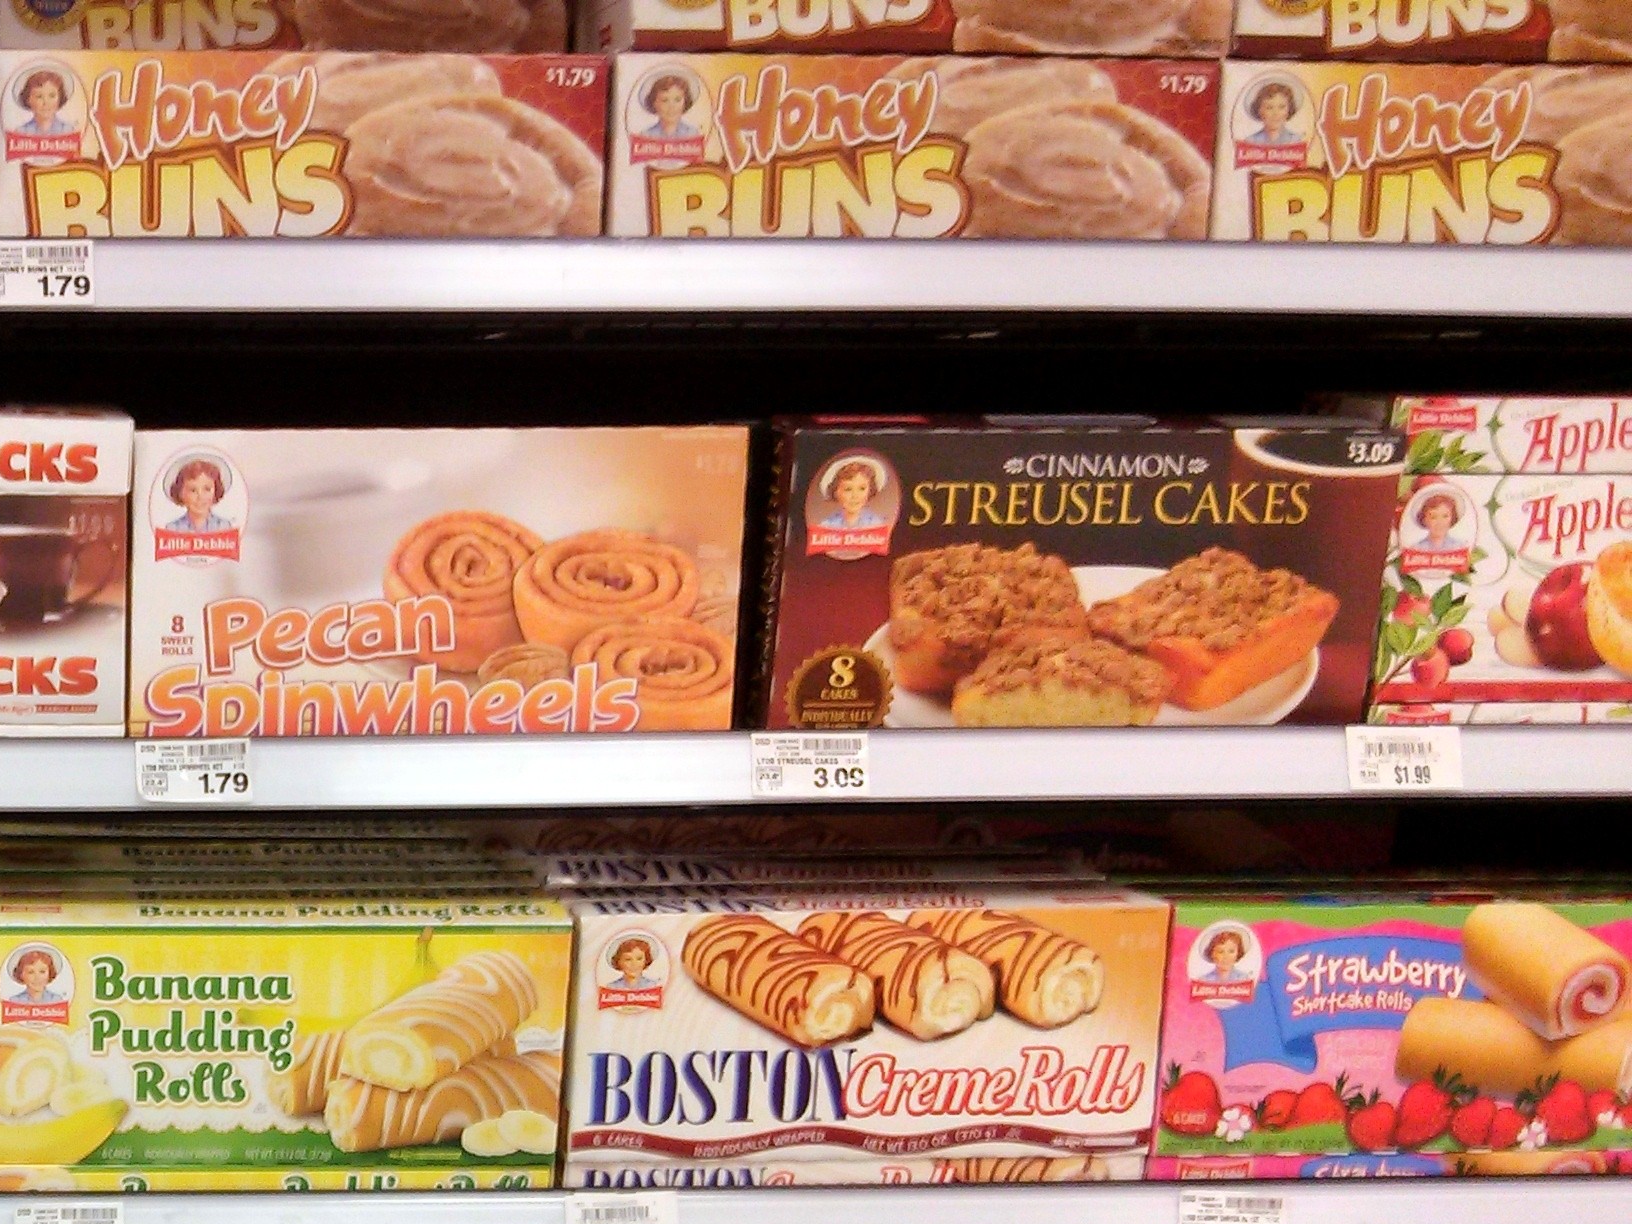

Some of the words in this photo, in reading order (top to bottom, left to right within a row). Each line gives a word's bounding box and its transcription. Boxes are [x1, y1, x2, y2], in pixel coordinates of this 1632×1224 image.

[546, 66, 595, 88] $1.79
[1159, 74, 1207, 95] $1.79
[91, 60, 318, 169] Honey
[718, 65, 938, 172] Honey
[1320, 74, 1533, 179] Honey
[26, 142, 353, 236] BUNS
[651, 142, 968, 238] BUNS
[1252, 150, 1560, 243] BUNS
[36, 275, 91, 298] 1.79
[1026, 453, 1188, 479] CINNAMON
[1348, 442, 1396, 464] $3.09
[908, 480, 1143, 528] STREUSEL
[1154, 480, 1311, 527] CAKES
[1518, 482, 1632, 557] Apple
[157, 537, 190, 552] Little
[192, 537, 236, 552] Debbie
[160, 636, 195, 646] SWEET
[170, 615, 185, 634] 8
[203, 596, 455, 677] Pecan
[161, 646, 194, 657] ROLLS
[829, 657, 854, 689] 8
[144, 662, 640, 731] Spinwheels
[197, 770, 249, 796] 1.79
[1394, 764, 1432, 786] $1.99
[90, 955, 293, 1002] Banana
[1286, 951, 1466, 995] Strawberry
[4, 1006, 34, 1020] Little
[35, 1006, 69, 1020] Debbie
[1292, 994, 1372, 1018] Shortcake
[1375, 991, 1413, 1011] Rolls
[90, 1008, 295, 1071] Pudding
[134, 1061, 247, 1105] Rolls
[586, 1048, 857, 1126] BOSTON
[842, 1054, 1016, 1118] Creme
[1015, 1045, 1146, 1116] Rolls
